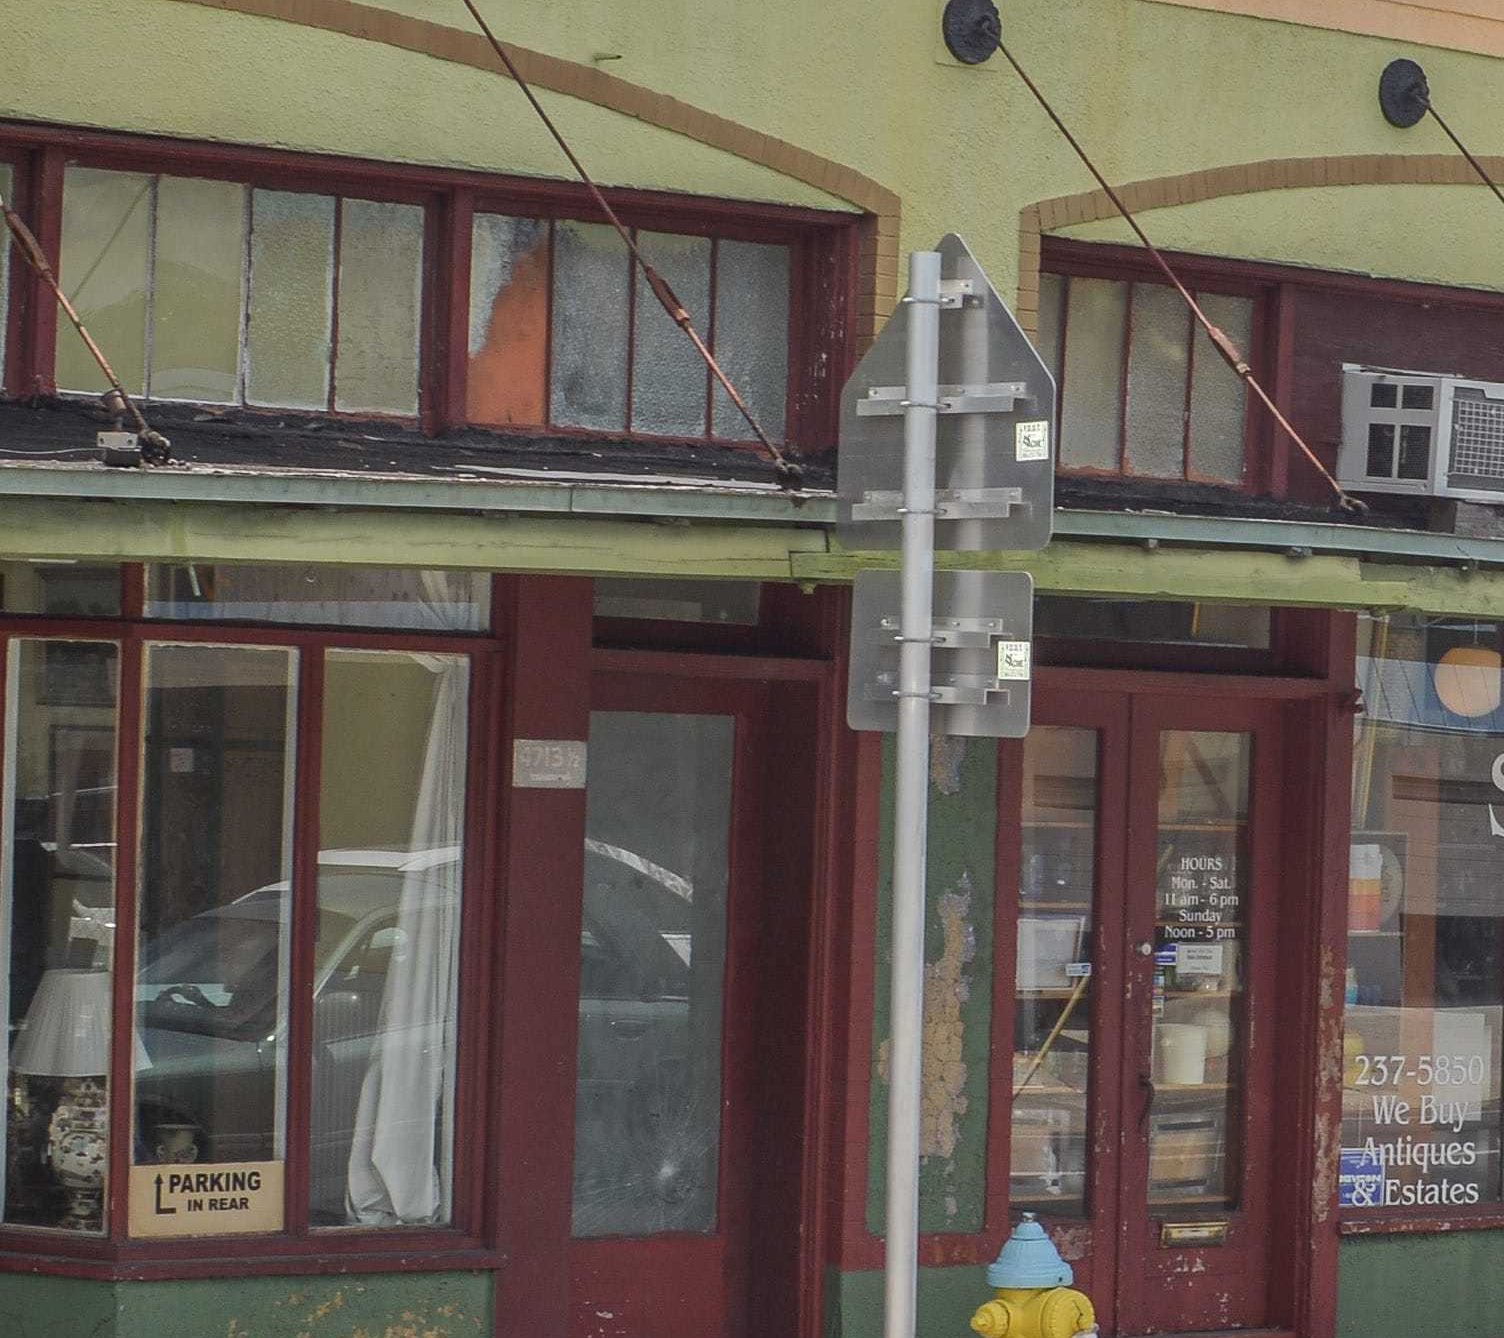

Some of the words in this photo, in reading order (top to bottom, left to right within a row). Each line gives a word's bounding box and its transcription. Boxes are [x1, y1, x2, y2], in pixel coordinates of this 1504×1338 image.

[1180, 857, 1223, 871] HOURS
[1171, 877, 1198, 890] Mon.
[1209, 877, 1232, 890] Sat.
[1209, 893, 1217, 906] 6
[1220, 895, 1239, 910] pm
[1179, 909, 1223, 925] Sunday
[1164, 926, 1196, 939] Noon
[1205, 926, 1214, 939] 5
[1216, 928, 1236, 941] pm
[1354, 1054, 1485, 1087] 237-5850
[1373, 1094, 1410, 1125] We
[1420, 1094, 1469, 1133] Buy
[1360, 1135, 1476, 1174] Antiques
[169, 1171, 262, 1194] PARKING
[1351, 1179, 1377, 1207] &
[1385, 1178, 1480, 1207] Estates
[187, 1199, 203, 1212] IN
[208, 1197, 250, 1211] REAR
